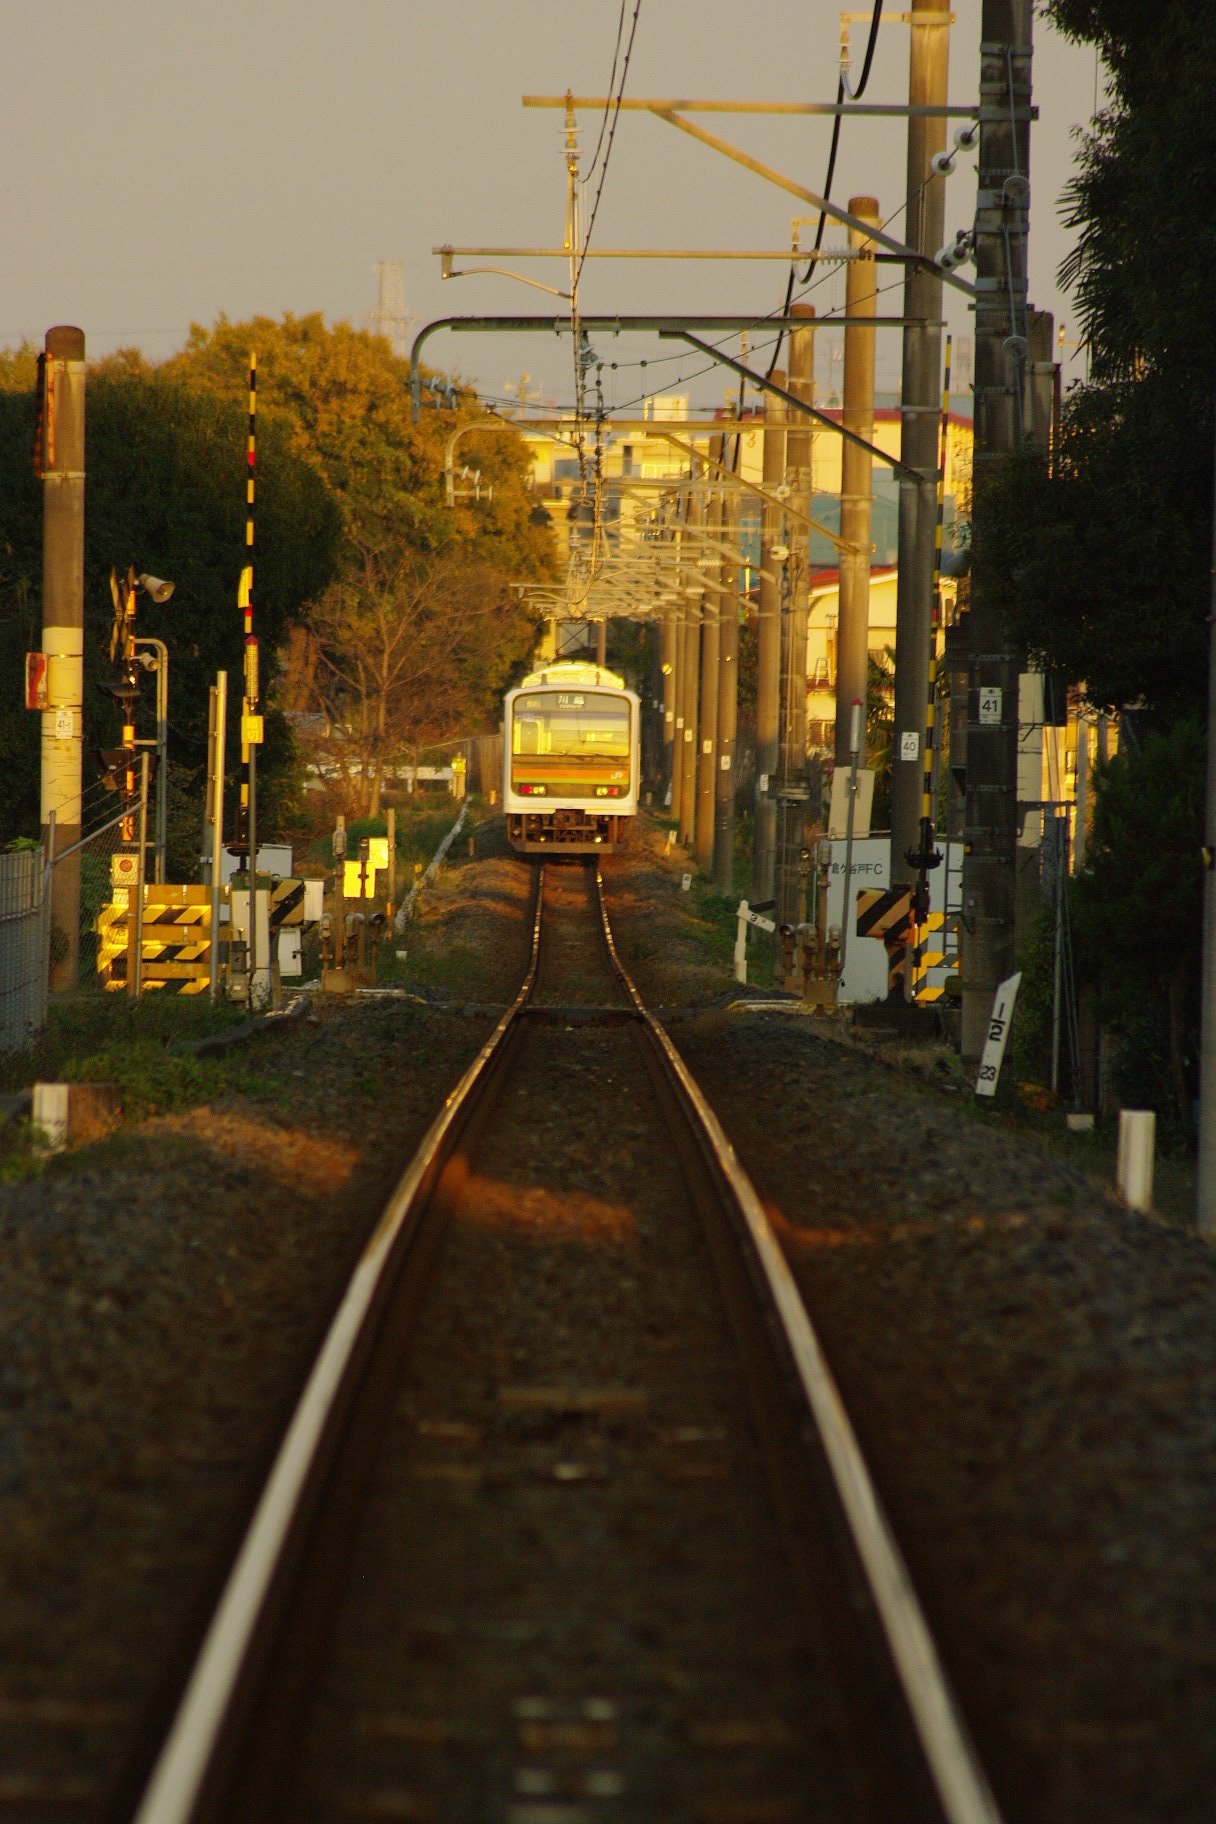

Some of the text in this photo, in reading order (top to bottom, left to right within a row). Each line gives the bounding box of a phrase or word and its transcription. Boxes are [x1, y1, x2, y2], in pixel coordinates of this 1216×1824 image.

[982, 700, 998, 713] 41
[903, 741, 917, 752] 40
[981, 1066, 996, 1080] 23
